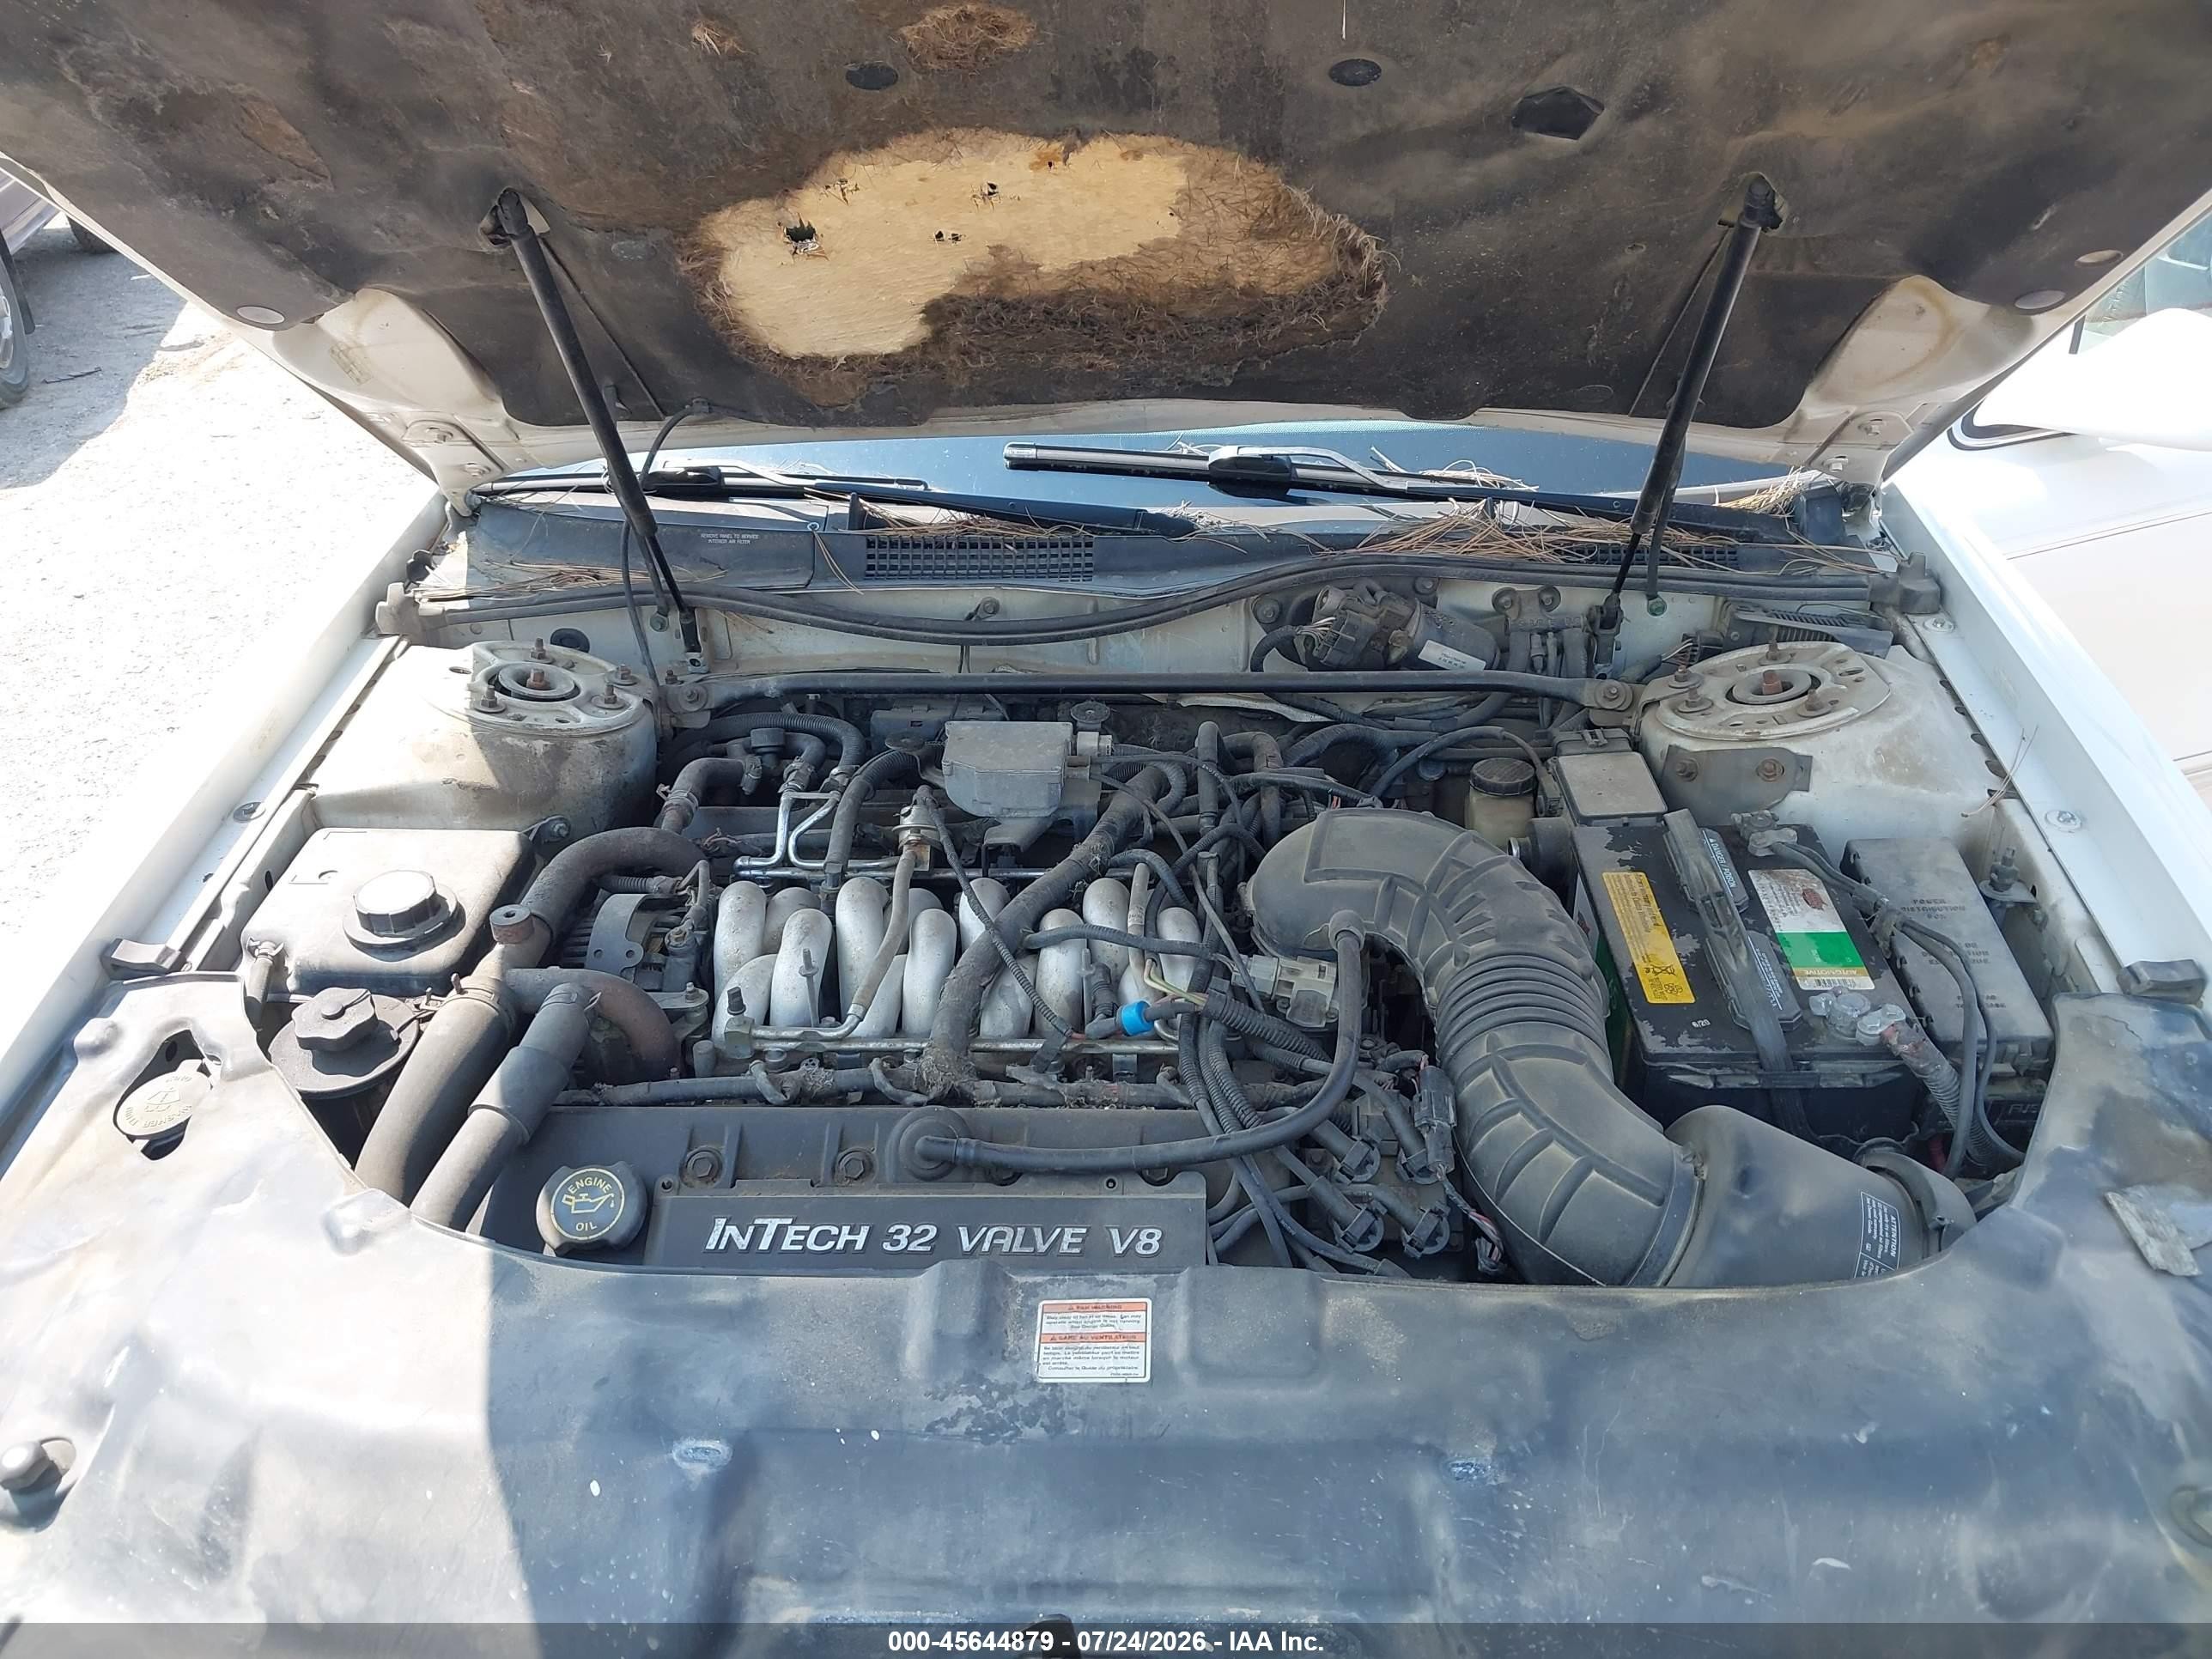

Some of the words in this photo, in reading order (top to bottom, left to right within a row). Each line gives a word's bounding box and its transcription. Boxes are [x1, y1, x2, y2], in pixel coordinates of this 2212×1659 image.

[2008, 1103, 2039, 1114] FUS
[568, 1176, 612, 1194] ENGINE
[575, 1221, 598, 1231] OIL
[881, 1224, 937, 1254] 32
[958, 1226, 1089, 1255] VALVE
[1109, 1228, 1164, 1257] V8
